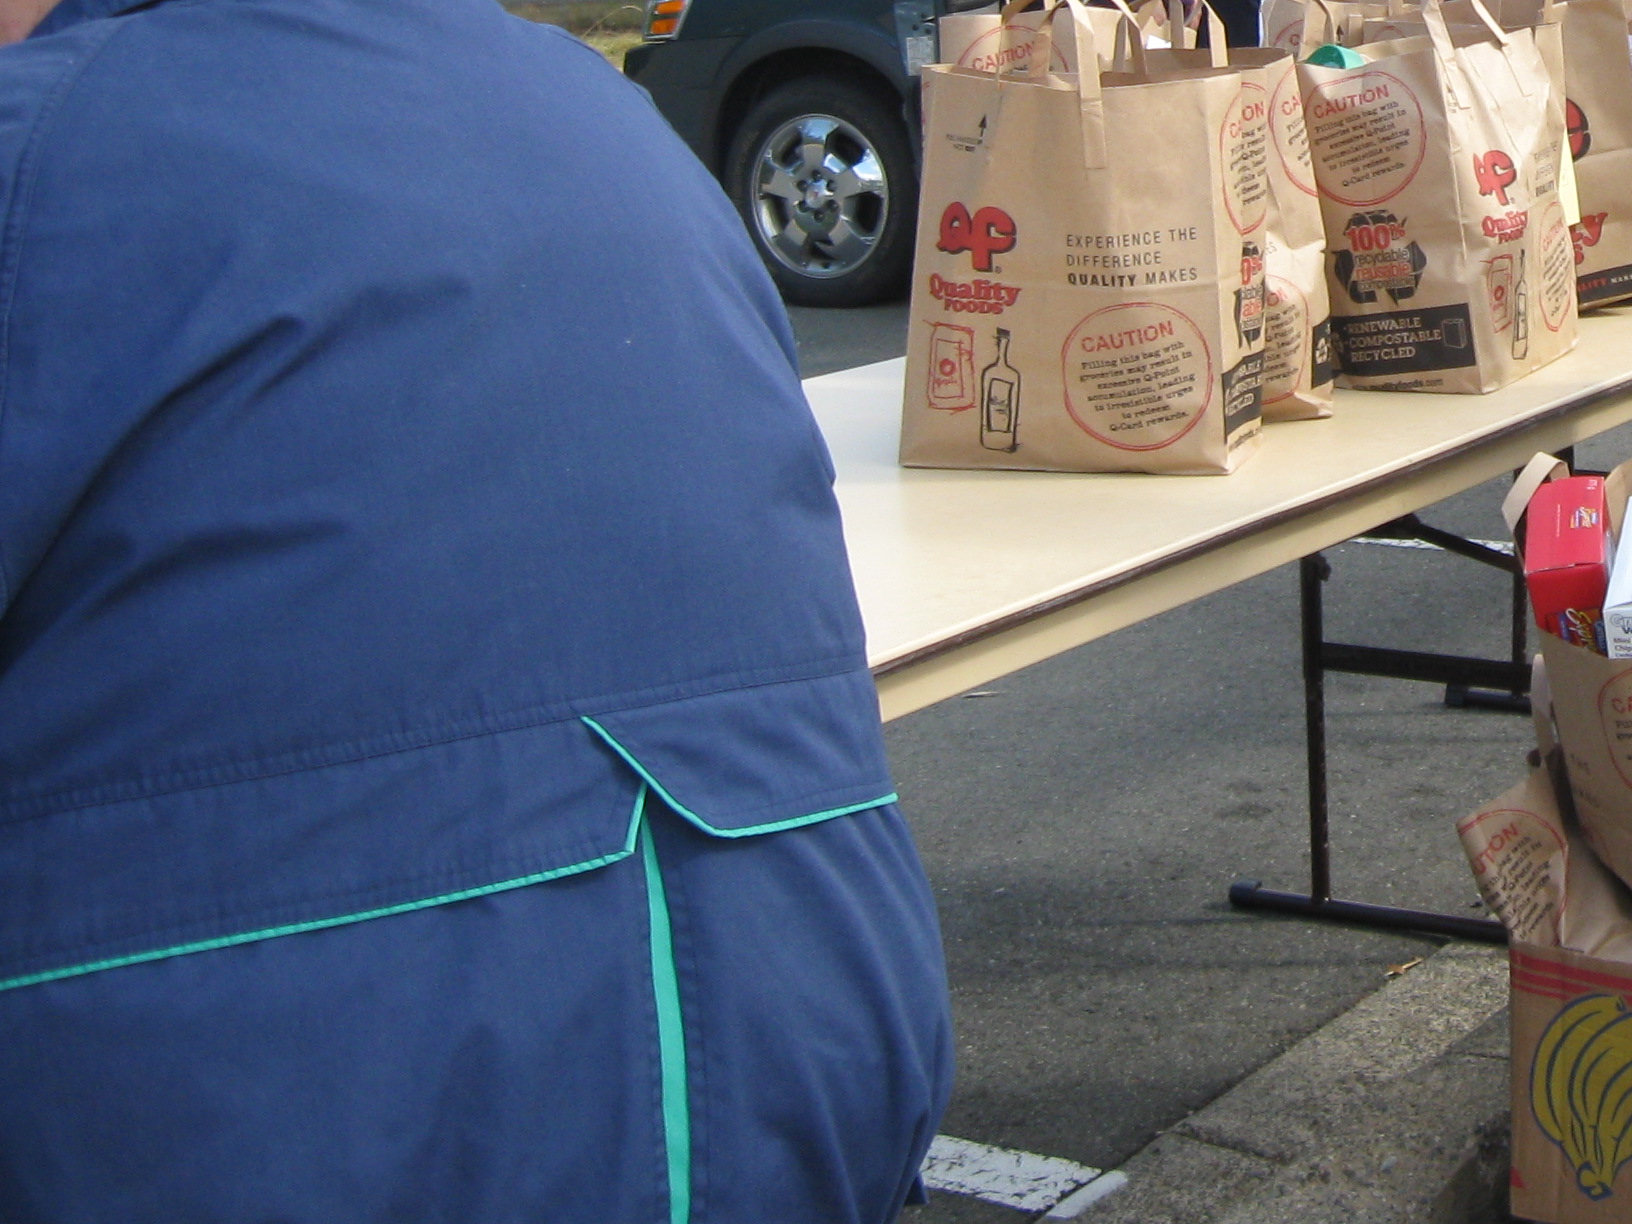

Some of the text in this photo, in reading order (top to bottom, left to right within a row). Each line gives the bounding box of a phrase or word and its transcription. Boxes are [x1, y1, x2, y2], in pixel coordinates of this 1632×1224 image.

[1313, 84, 1390, 119] CAUTION
[1066, 227, 1198, 249] EXPERIENCE THE
[1346, 223, 1407, 252] 100%
[1066, 251, 1162, 269] DIFFERENCE
[1067, 267, 1199, 288] QUALITY MAKES
[929, 273, 1022, 307] Quality
[943, 297, 1004, 315] FOODS
[1081, 320, 1175, 353] CAUTION
[1348, 317, 1421, 335] RENEWABLE
[1348, 329, 1442, 349] COMPOSTABLE
[1081, 341, 1185, 370] Filling this bag with
[1350, 346, 1417, 363] RECYCLED
[1127, 364, 1147, 376] may
